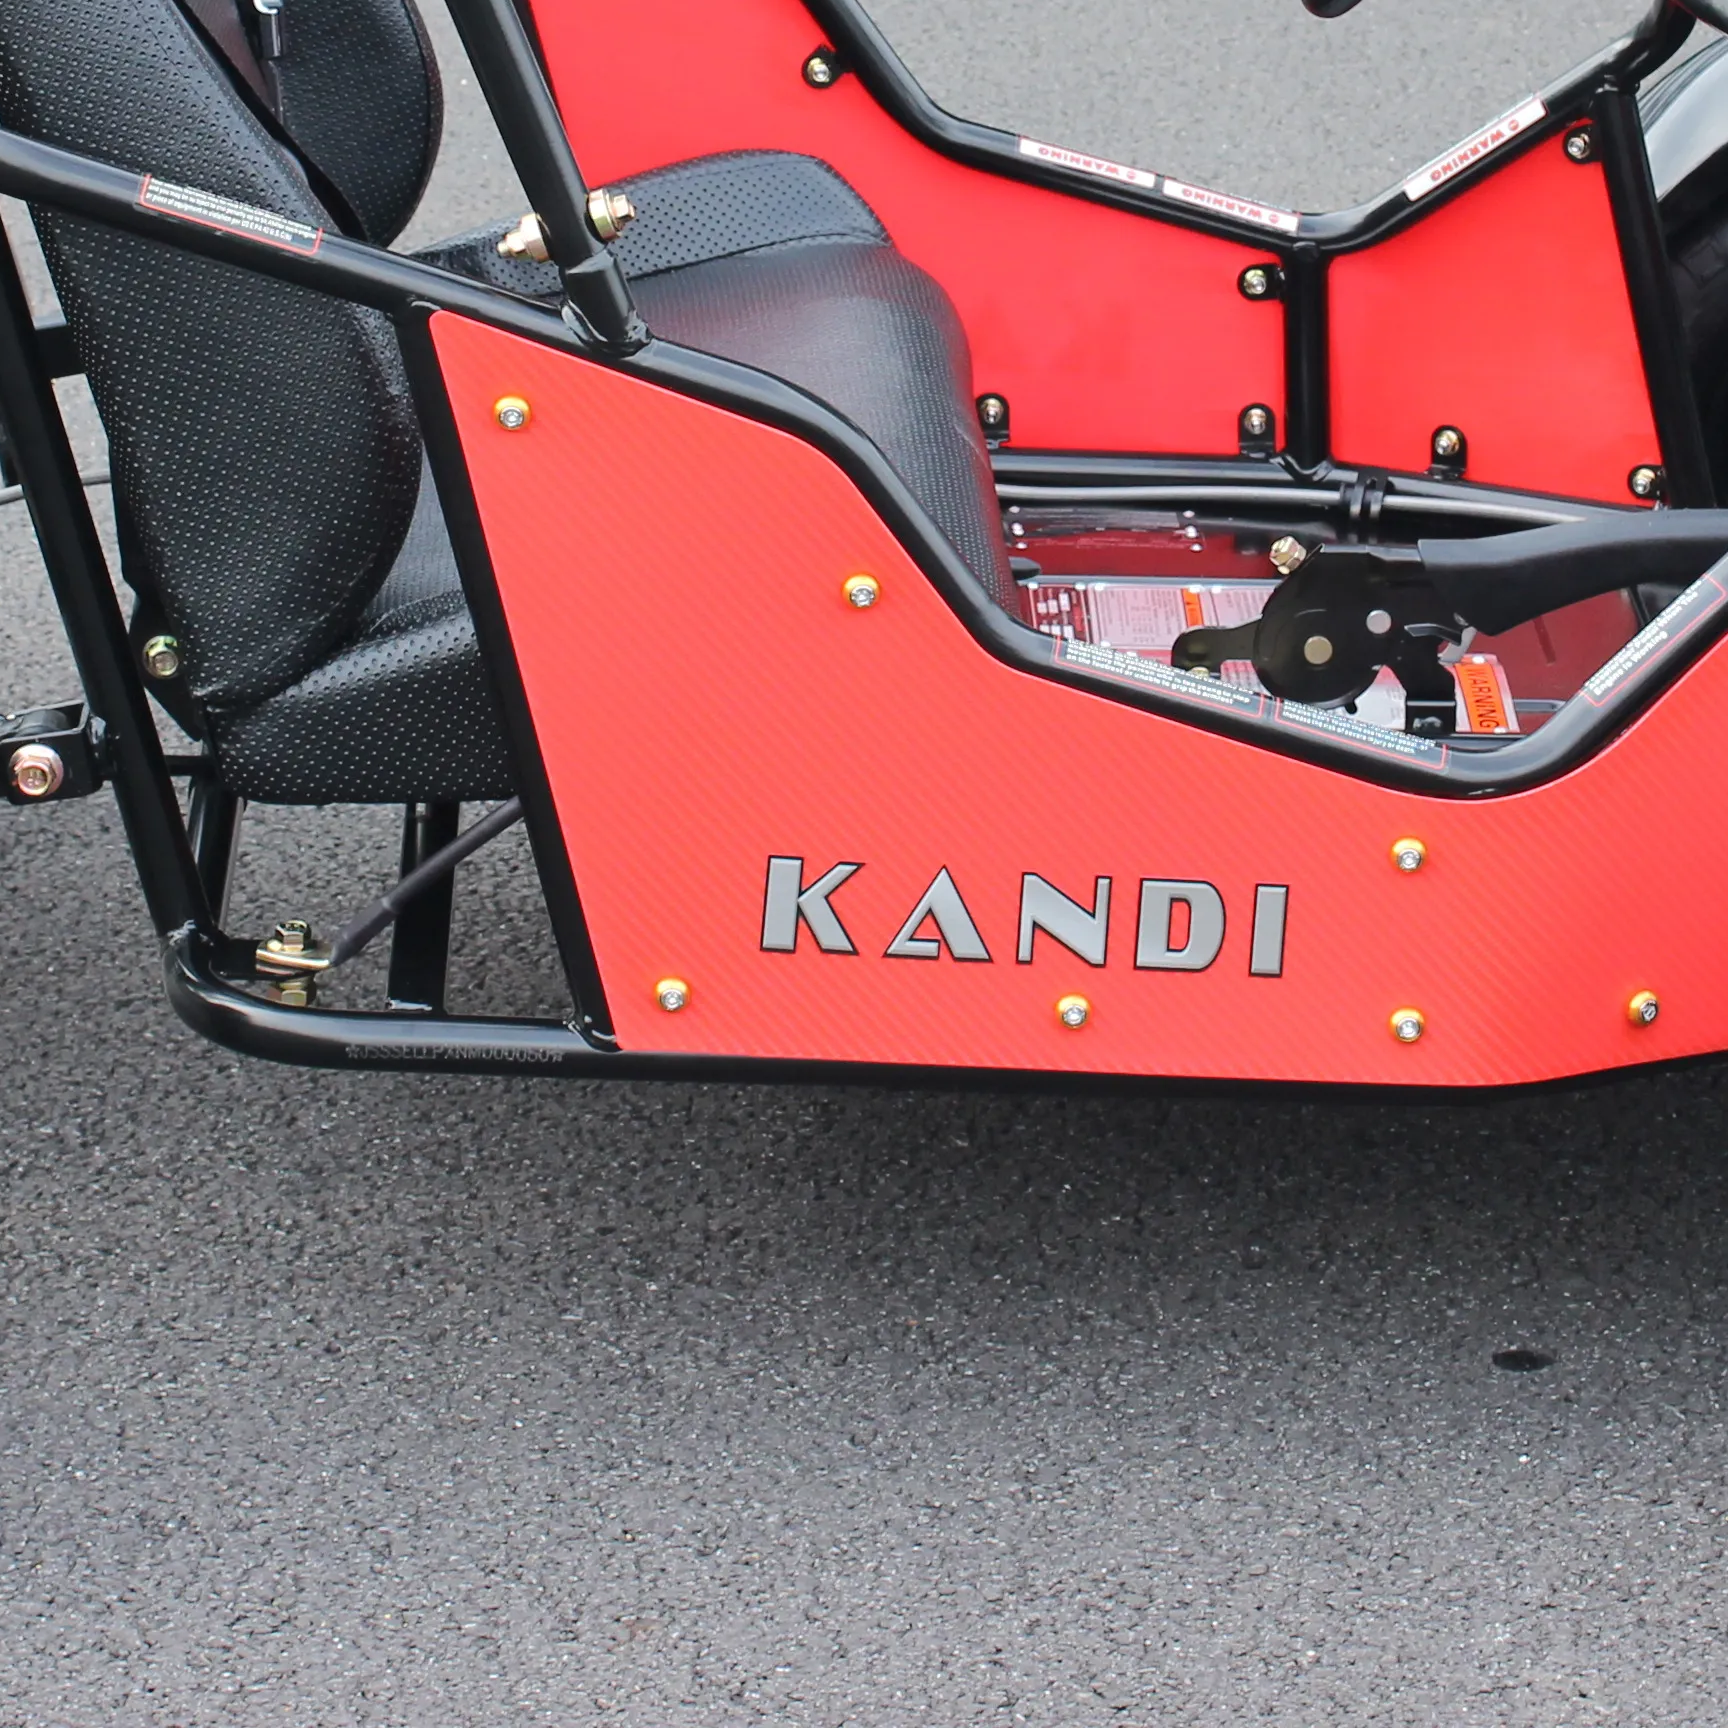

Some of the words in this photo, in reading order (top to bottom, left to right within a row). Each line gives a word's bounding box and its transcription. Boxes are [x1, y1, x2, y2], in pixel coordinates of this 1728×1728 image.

[1038, 146, 1120, 176] WARNING
[1430, 129, 1505, 182] WARNING
[1182, 188, 1262, 219] WARNING
[1591, 665, 1626, 697] Engine
[1629, 628, 1669, 665] Working
[1468, 665, 1501, 731] WARNING
[759, 853, 1290, 979] KANDI
